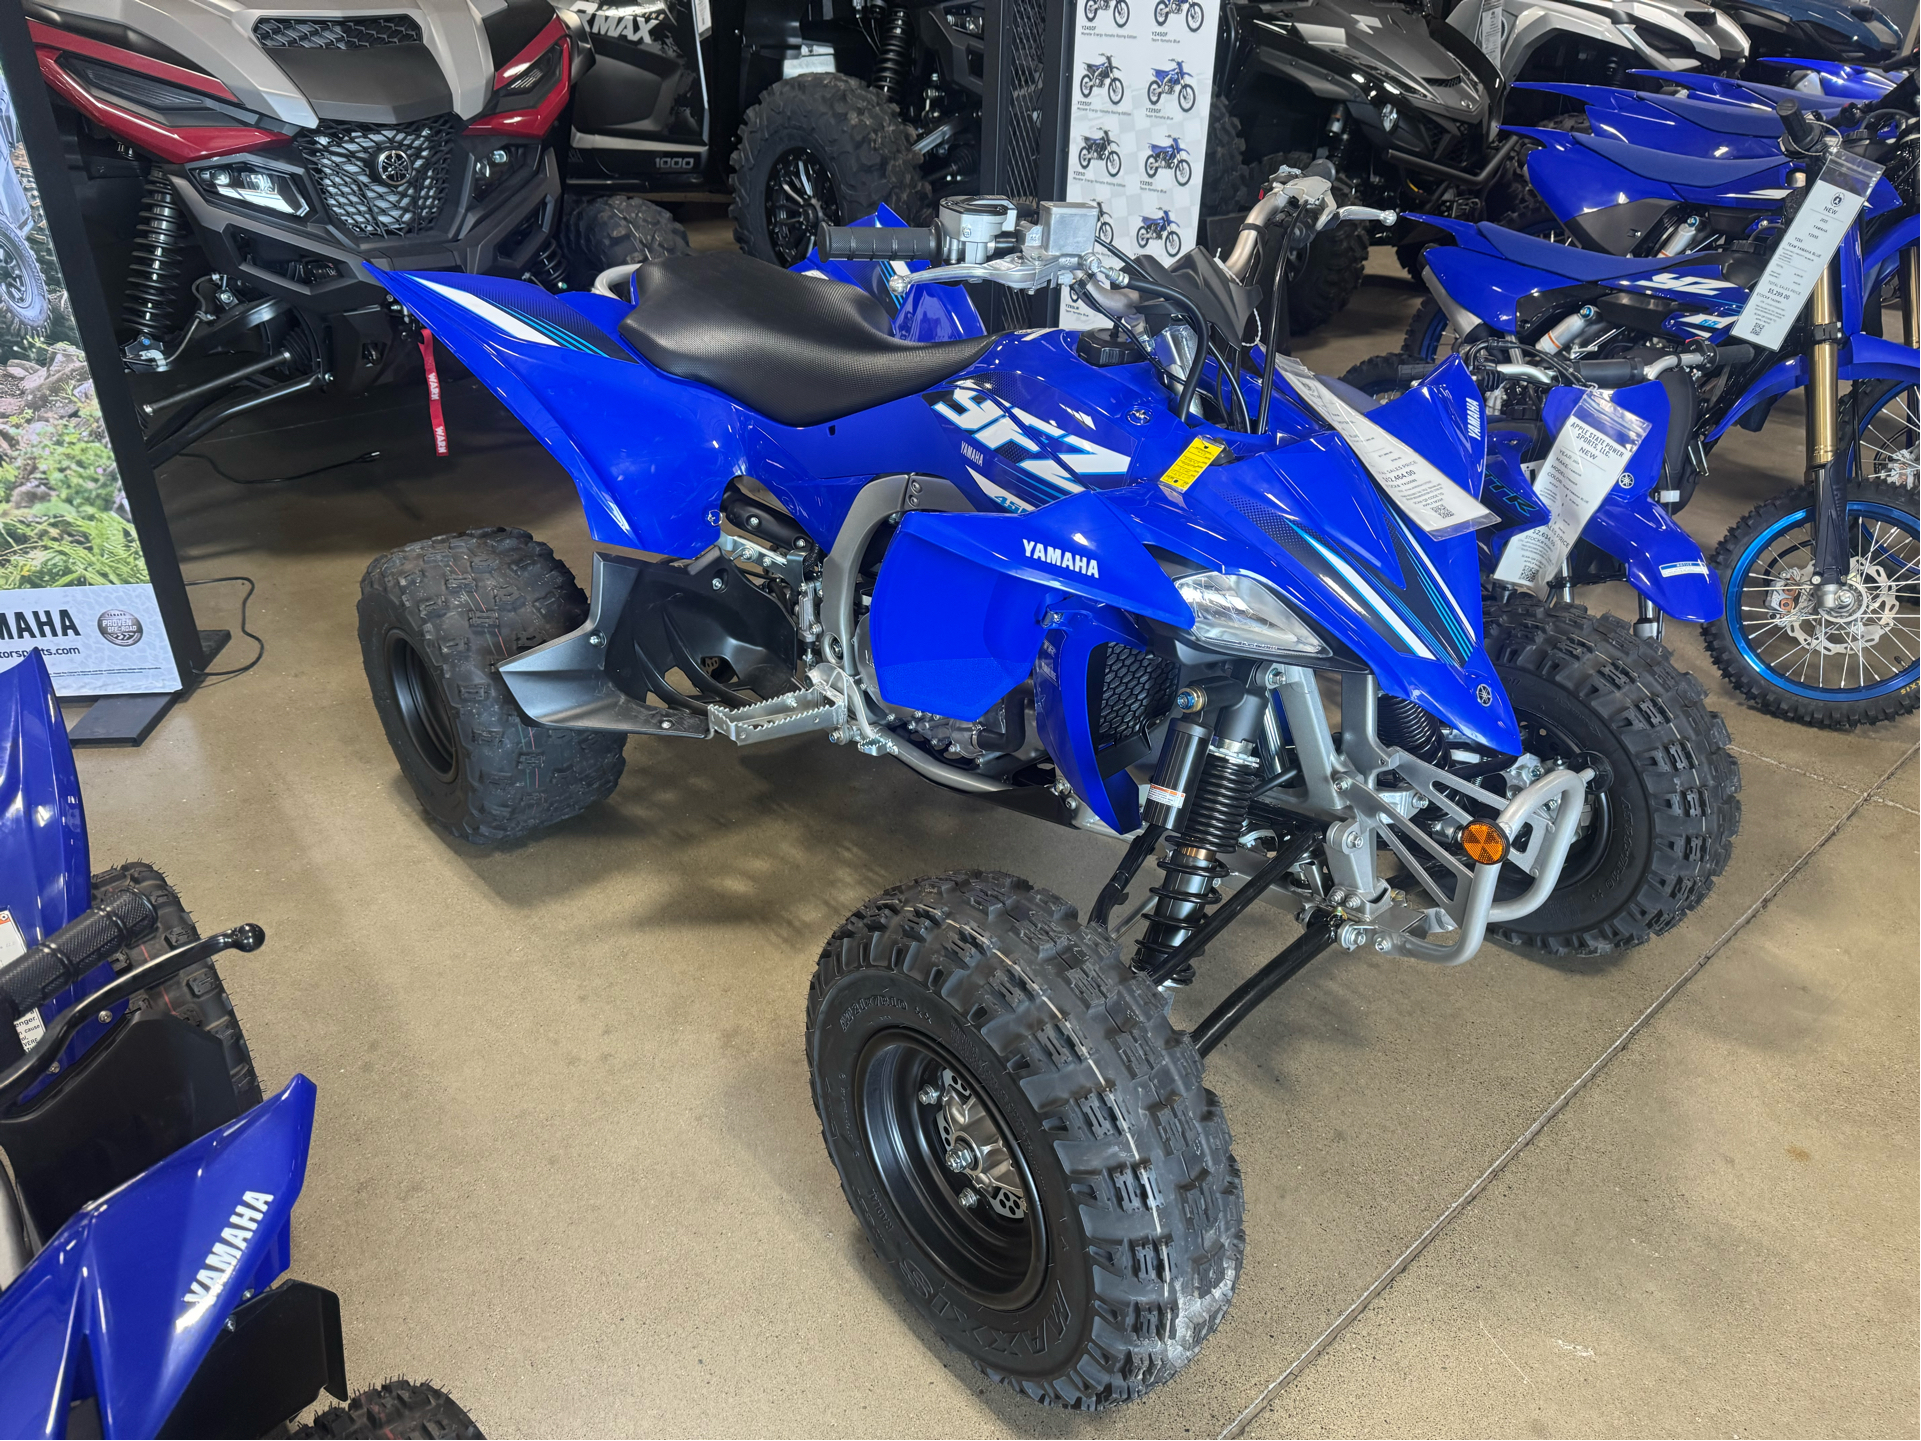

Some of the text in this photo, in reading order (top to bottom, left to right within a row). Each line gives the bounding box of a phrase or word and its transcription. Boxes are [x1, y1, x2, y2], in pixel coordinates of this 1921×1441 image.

[569, 1, 660, 44] RMAX
[655, 157, 694, 168] 1000
[1823, 205, 1838, 215] NEW
[1634, 272, 1739, 296] YZ
[428, 372, 439, 401] WARN
[1465, 397, 1481, 441] YAMAHA
[435, 426, 447, 454] WARN
[1570, 421, 1625, 458] APPLE STATE POWER
[1575, 432, 1599, 451] SPORTS,
[960, 440, 984, 467] YAMAHA
[1578, 446, 1599, 461] NEW
[1557, 533, 1571, 549] PRICE
[1022, 538, 1100, 579] YAMAHA
[102, 618, 133, 628] PROVEN
[107, 625, 138, 633] OFF-ROAD
[0, 646, 81, 658] torspts.com
[24, 1024, 41, 1034] cause
[183, 1190, 275, 1304] YAMAHA
[900, 1257, 1072, 1358] MAXXIS
